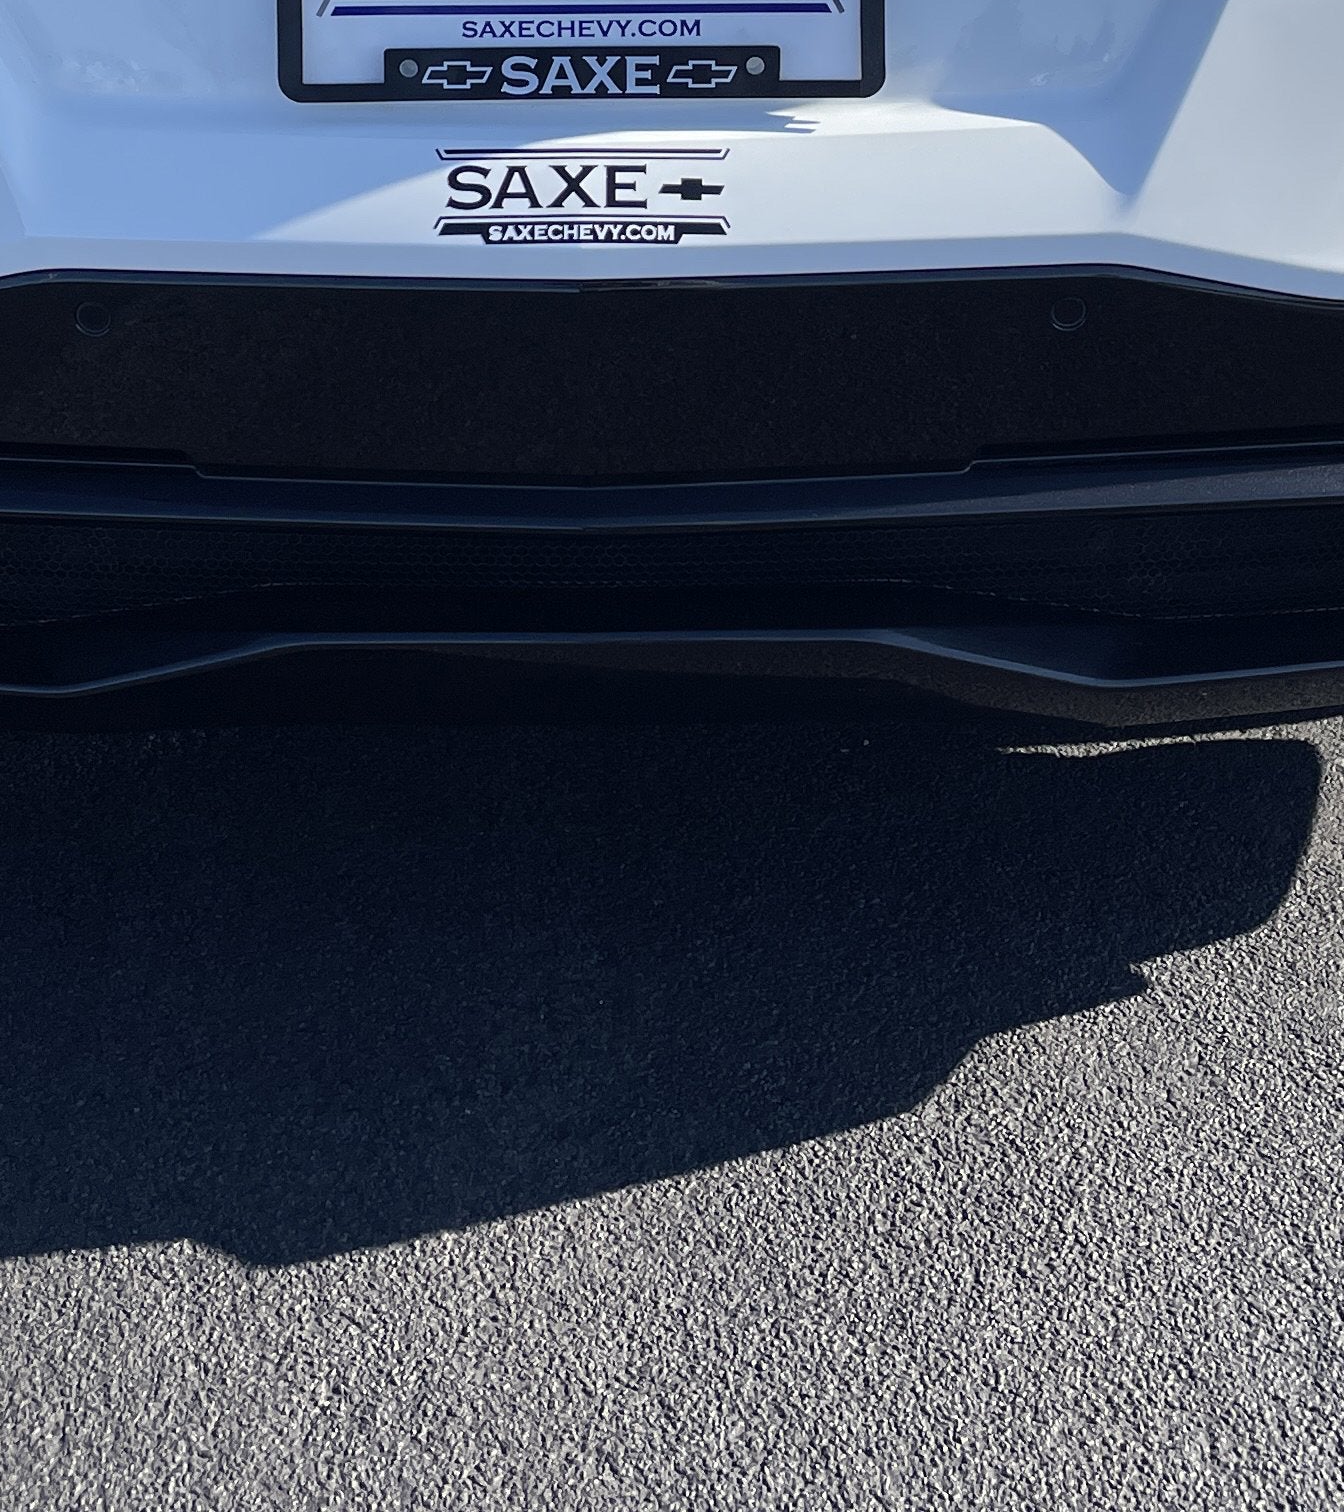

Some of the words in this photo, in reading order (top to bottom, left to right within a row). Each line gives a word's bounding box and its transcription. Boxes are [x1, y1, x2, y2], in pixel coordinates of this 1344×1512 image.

[461, 18, 702, 40] SAXECHEVY.COM
[500, 55, 661, 96] SAXE
[445, 164, 648, 210] SAXE
[488, 223, 676, 243] SAXECHEVY.COM
